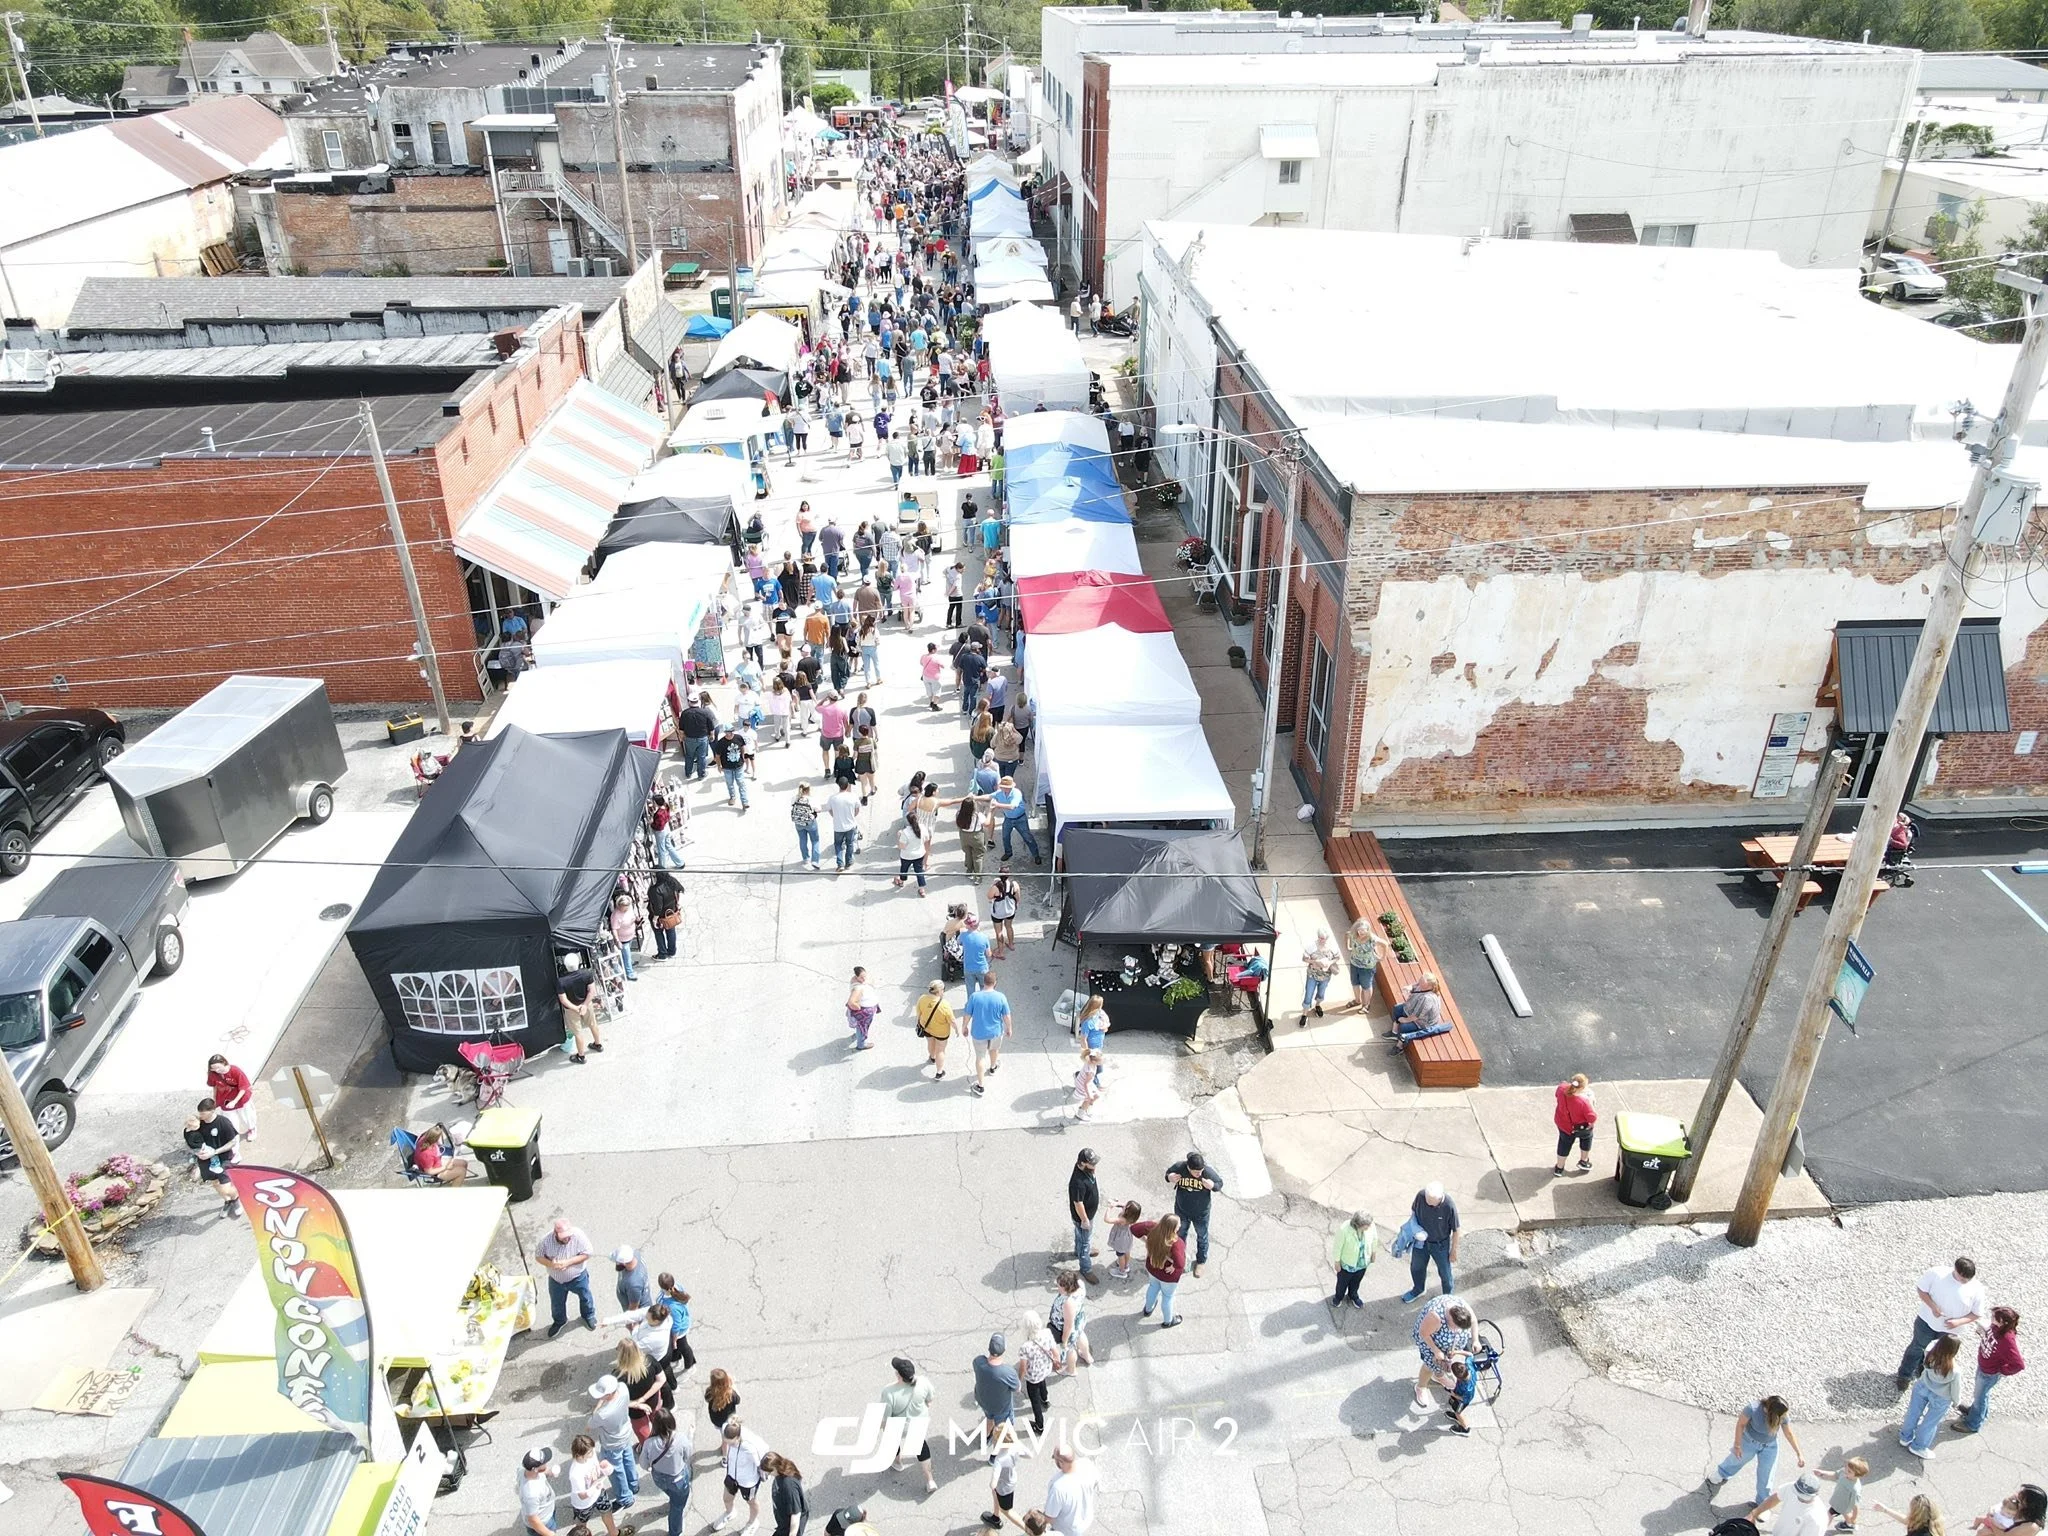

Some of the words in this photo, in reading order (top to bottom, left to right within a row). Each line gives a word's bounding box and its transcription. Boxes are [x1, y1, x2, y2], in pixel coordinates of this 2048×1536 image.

[1178, 1177, 1204, 1190] TIGERS
[254, 1178, 316, 1295] SNOW
[389, 1485, 406, 1521] COLD
